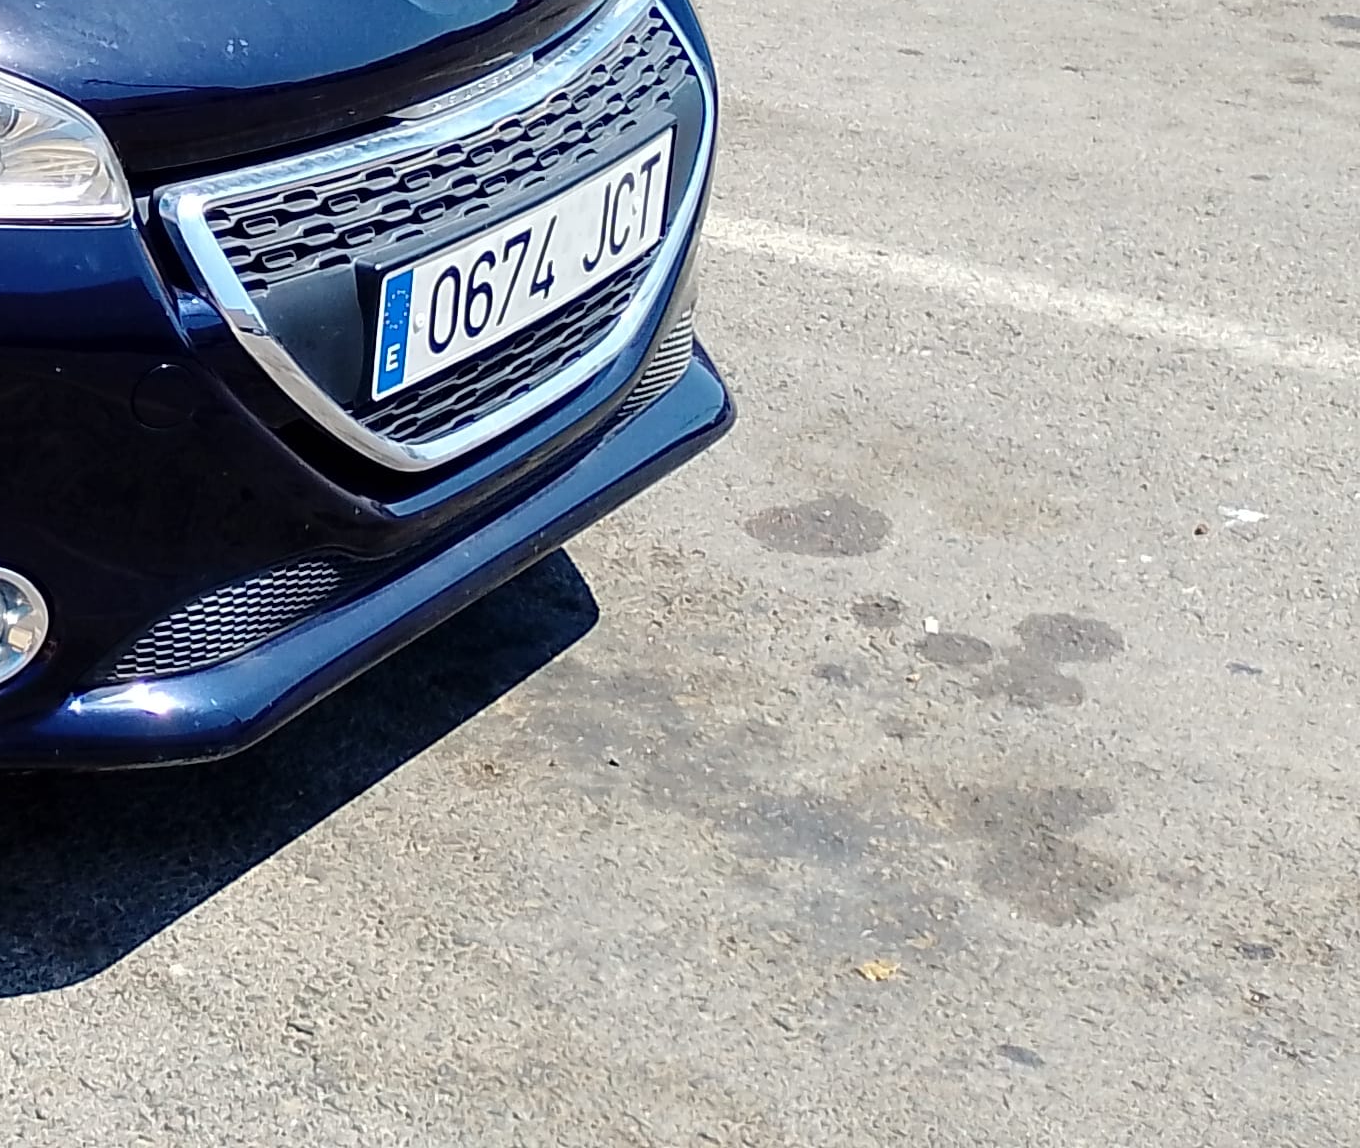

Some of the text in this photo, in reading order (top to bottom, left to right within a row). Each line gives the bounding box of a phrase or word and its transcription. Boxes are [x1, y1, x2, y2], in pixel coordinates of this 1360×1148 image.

[428, 151, 662, 355] 0674 JCT
[384, 342, 402, 373] E
